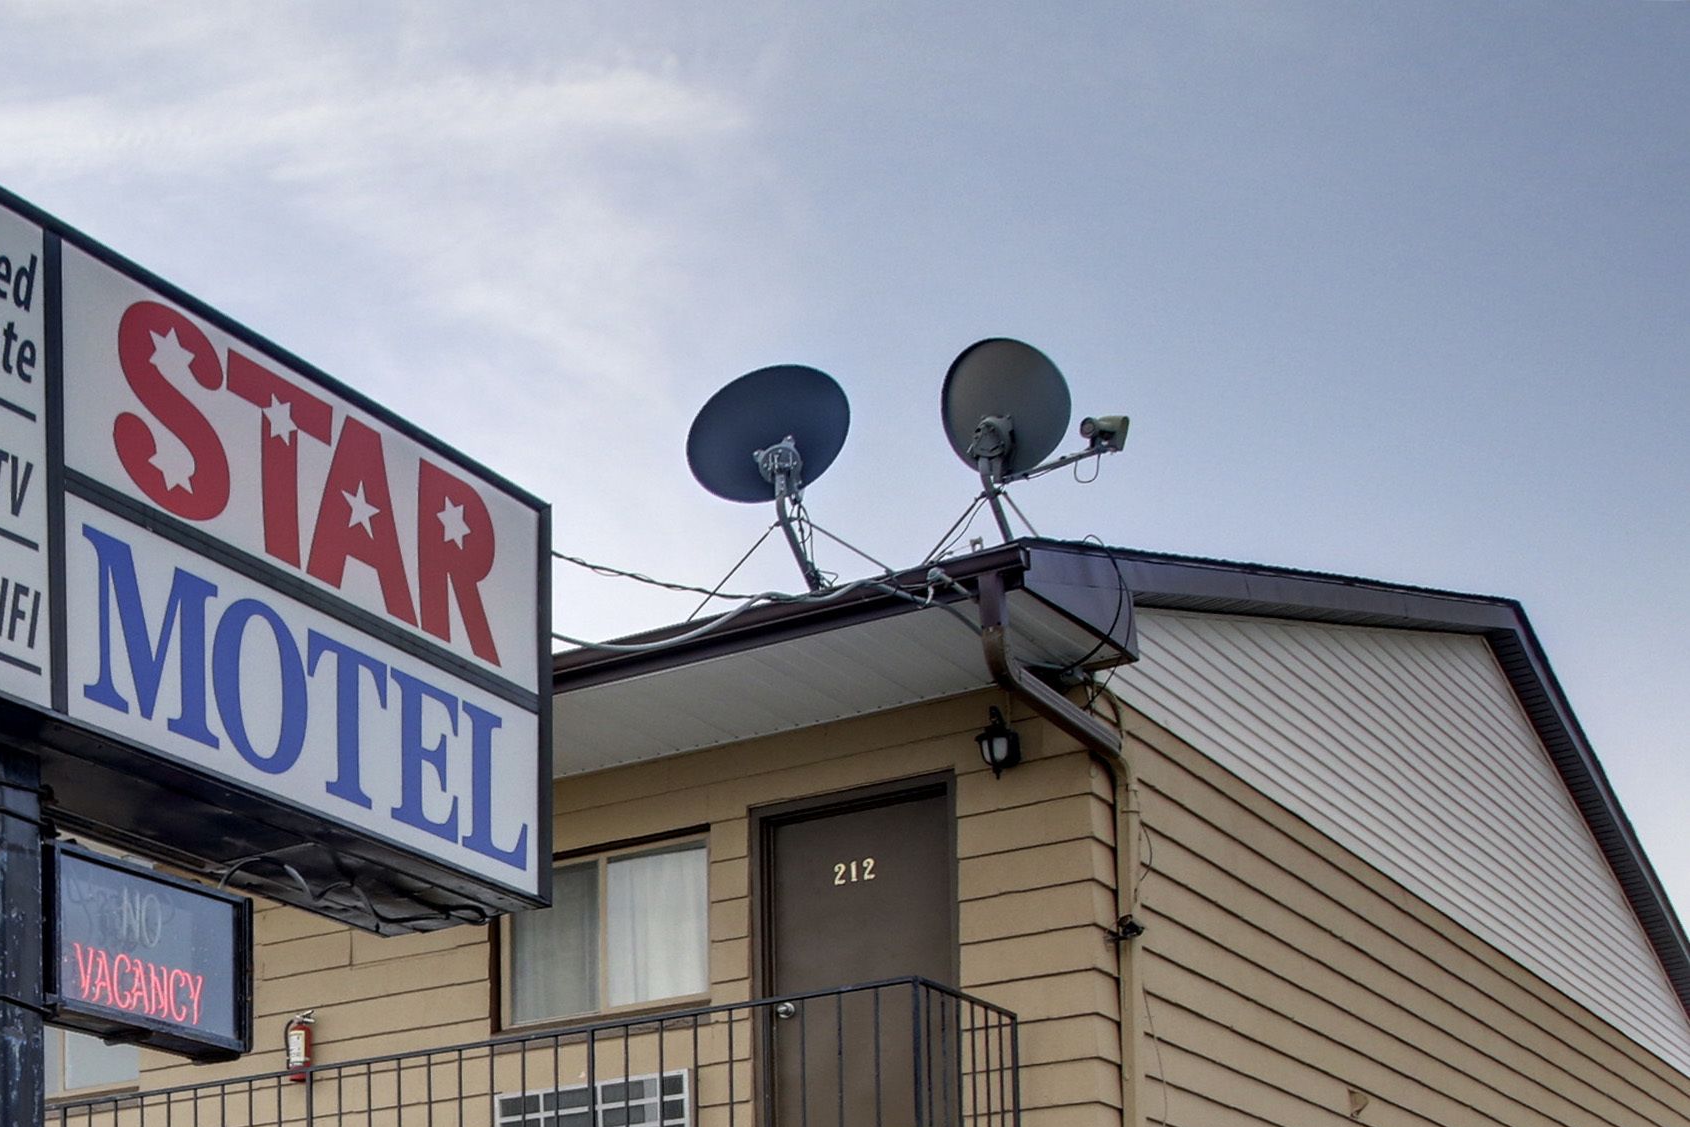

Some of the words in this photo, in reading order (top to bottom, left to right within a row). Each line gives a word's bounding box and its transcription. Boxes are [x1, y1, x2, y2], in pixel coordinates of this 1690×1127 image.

[113, 299, 502, 668] STAR
[82, 522, 528, 872] MOTEL
[833, 857, 876, 886] 212
[122, 885, 162, 949] NO
[73, 942, 204, 1025] VACANCY
